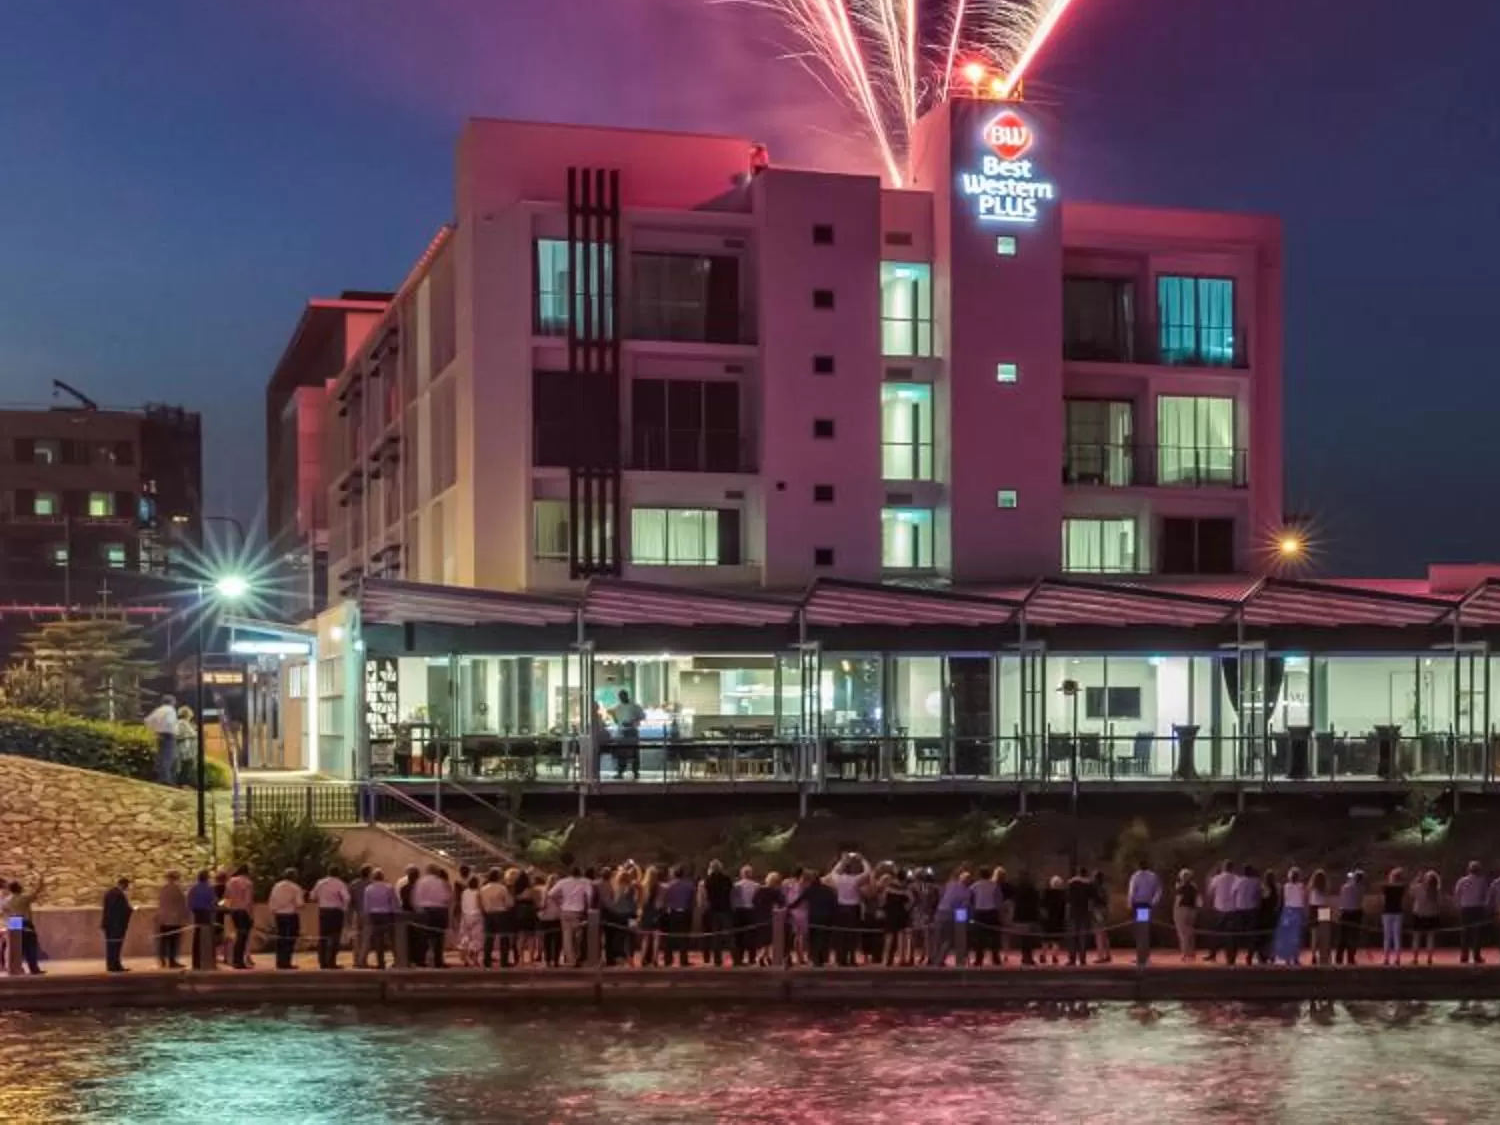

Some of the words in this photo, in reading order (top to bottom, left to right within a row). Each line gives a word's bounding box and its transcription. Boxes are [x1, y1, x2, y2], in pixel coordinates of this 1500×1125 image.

[991, 125, 1026, 146] BW
[983, 156, 1033, 178] Best
[962, 173, 1054, 199] Western
[979, 195, 1038, 217] PLUS
